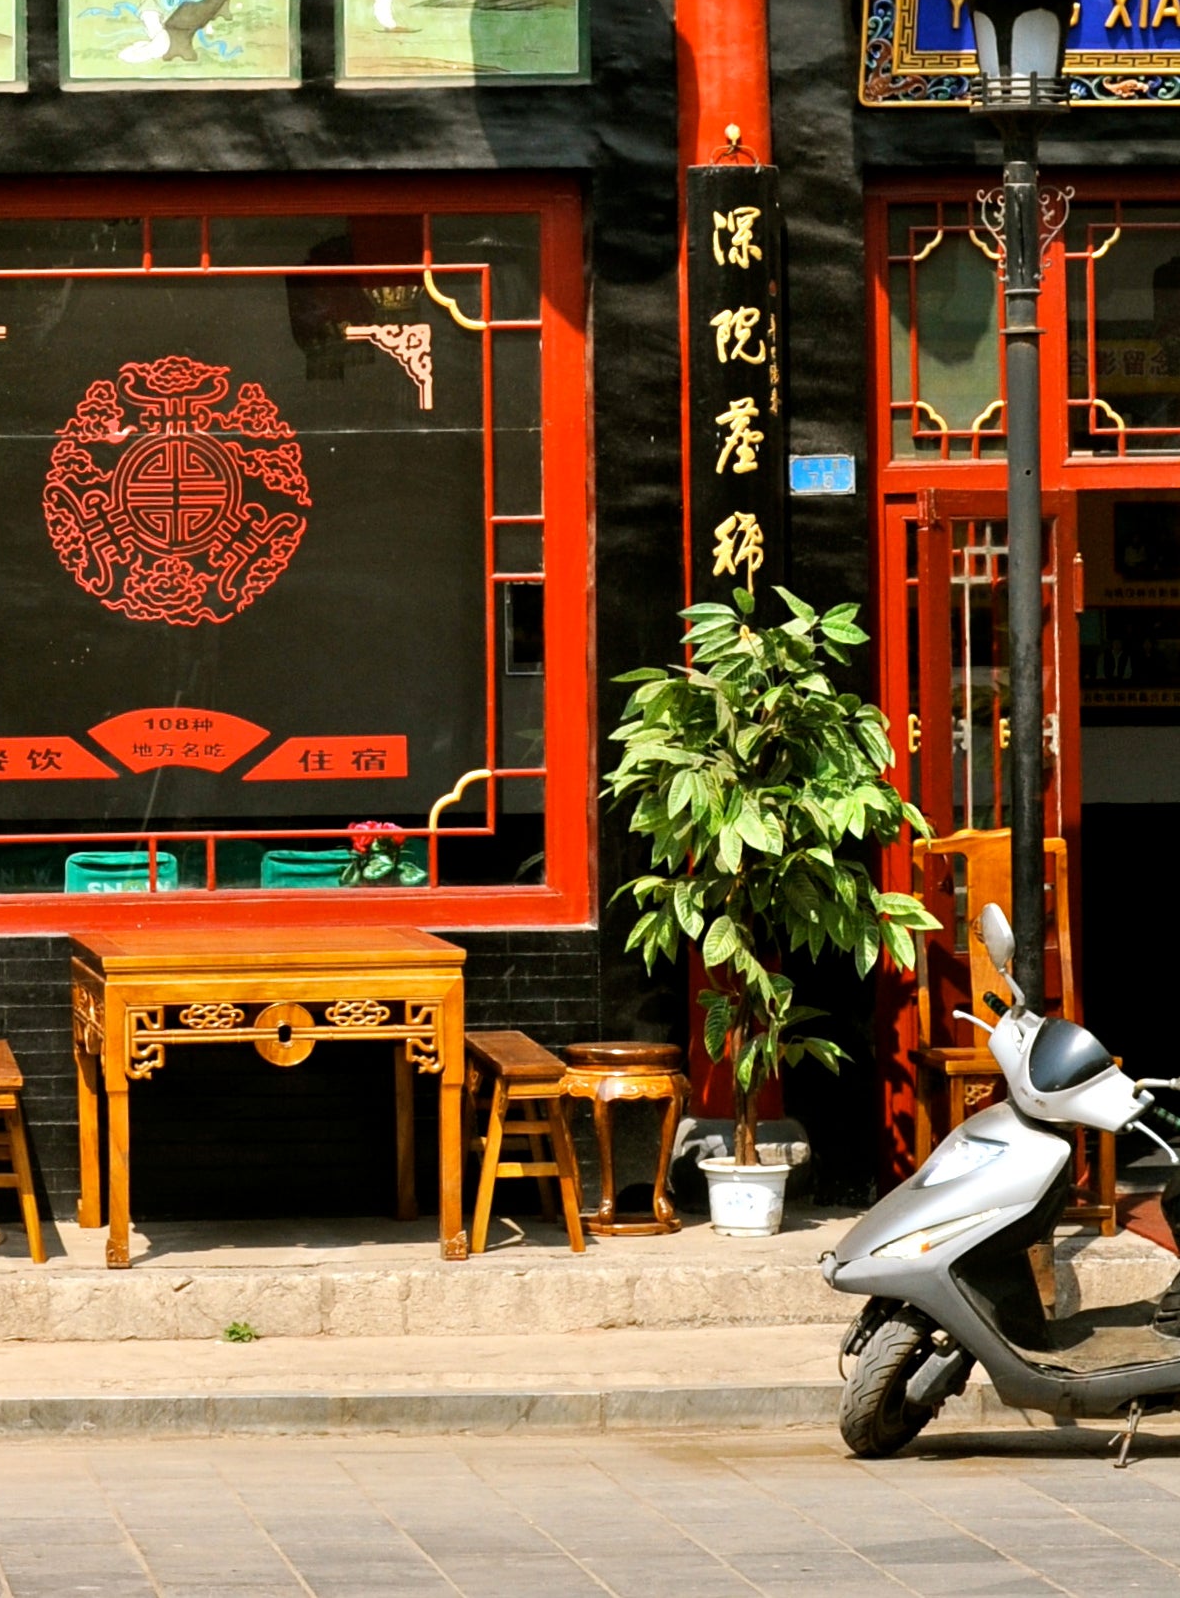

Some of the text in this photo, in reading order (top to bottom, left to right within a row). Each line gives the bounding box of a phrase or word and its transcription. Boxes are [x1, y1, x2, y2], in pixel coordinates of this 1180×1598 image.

[143, 717, 214, 733] 108种
[131, 742, 226, 758] 地方名吃
[298, 748, 387, 773] 住宿
